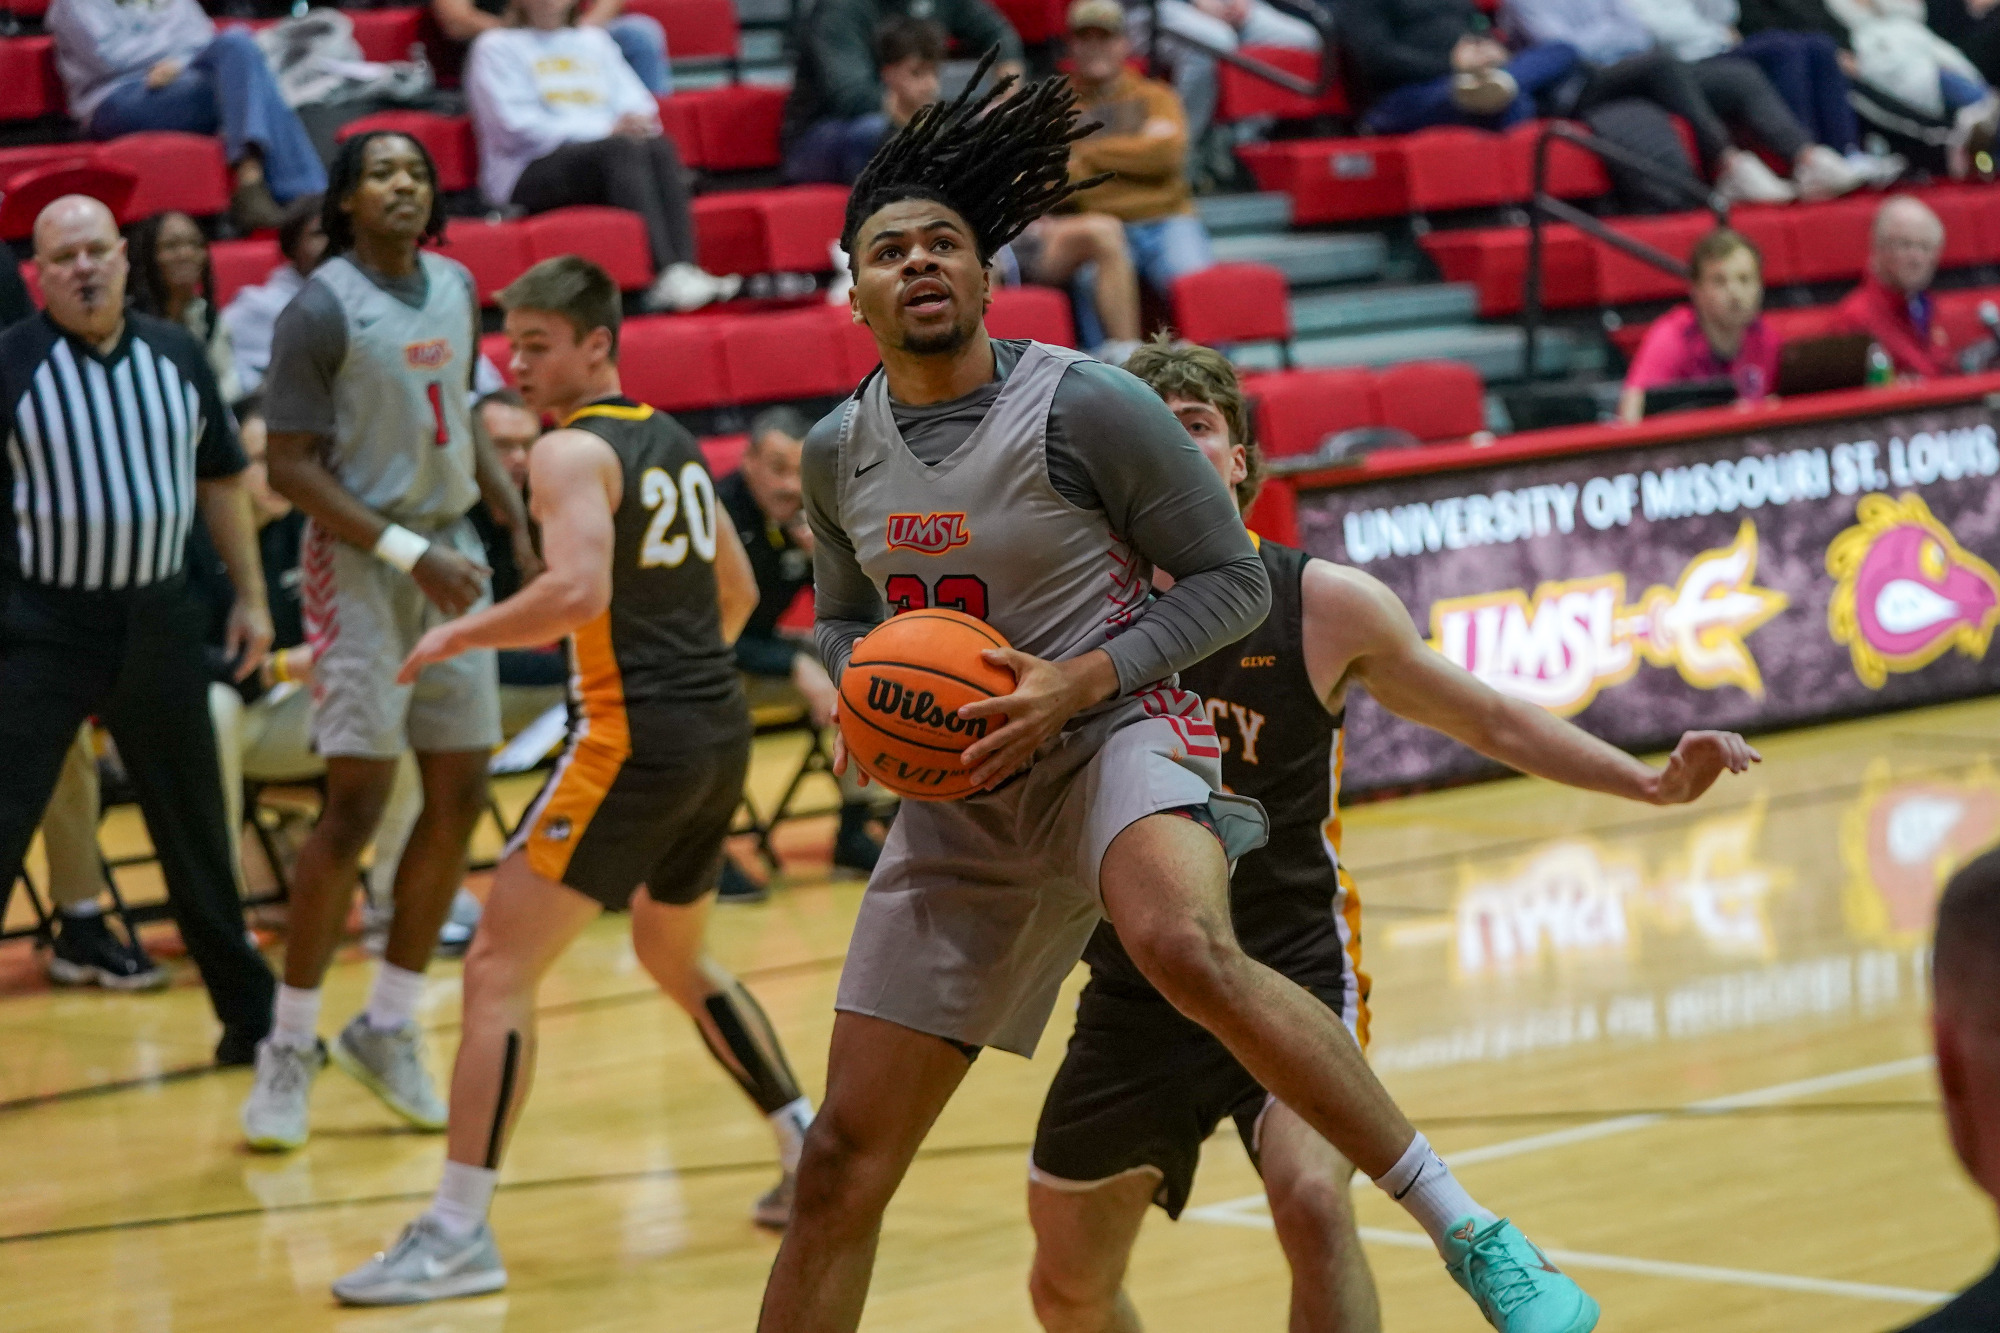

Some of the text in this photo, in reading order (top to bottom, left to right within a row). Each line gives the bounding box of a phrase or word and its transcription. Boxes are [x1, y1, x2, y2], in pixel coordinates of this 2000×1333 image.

[426, 381, 450, 447] 1
[639, 461, 717, 569] 20
[887, 512, 970, 555] UMSL
[1343, 424, 2000, 564] UNIVERSITY OF MISSOURI ST. LOUIS
[1436, 582, 1635, 710] UMSL
[867, 675, 988, 740] Wilson
